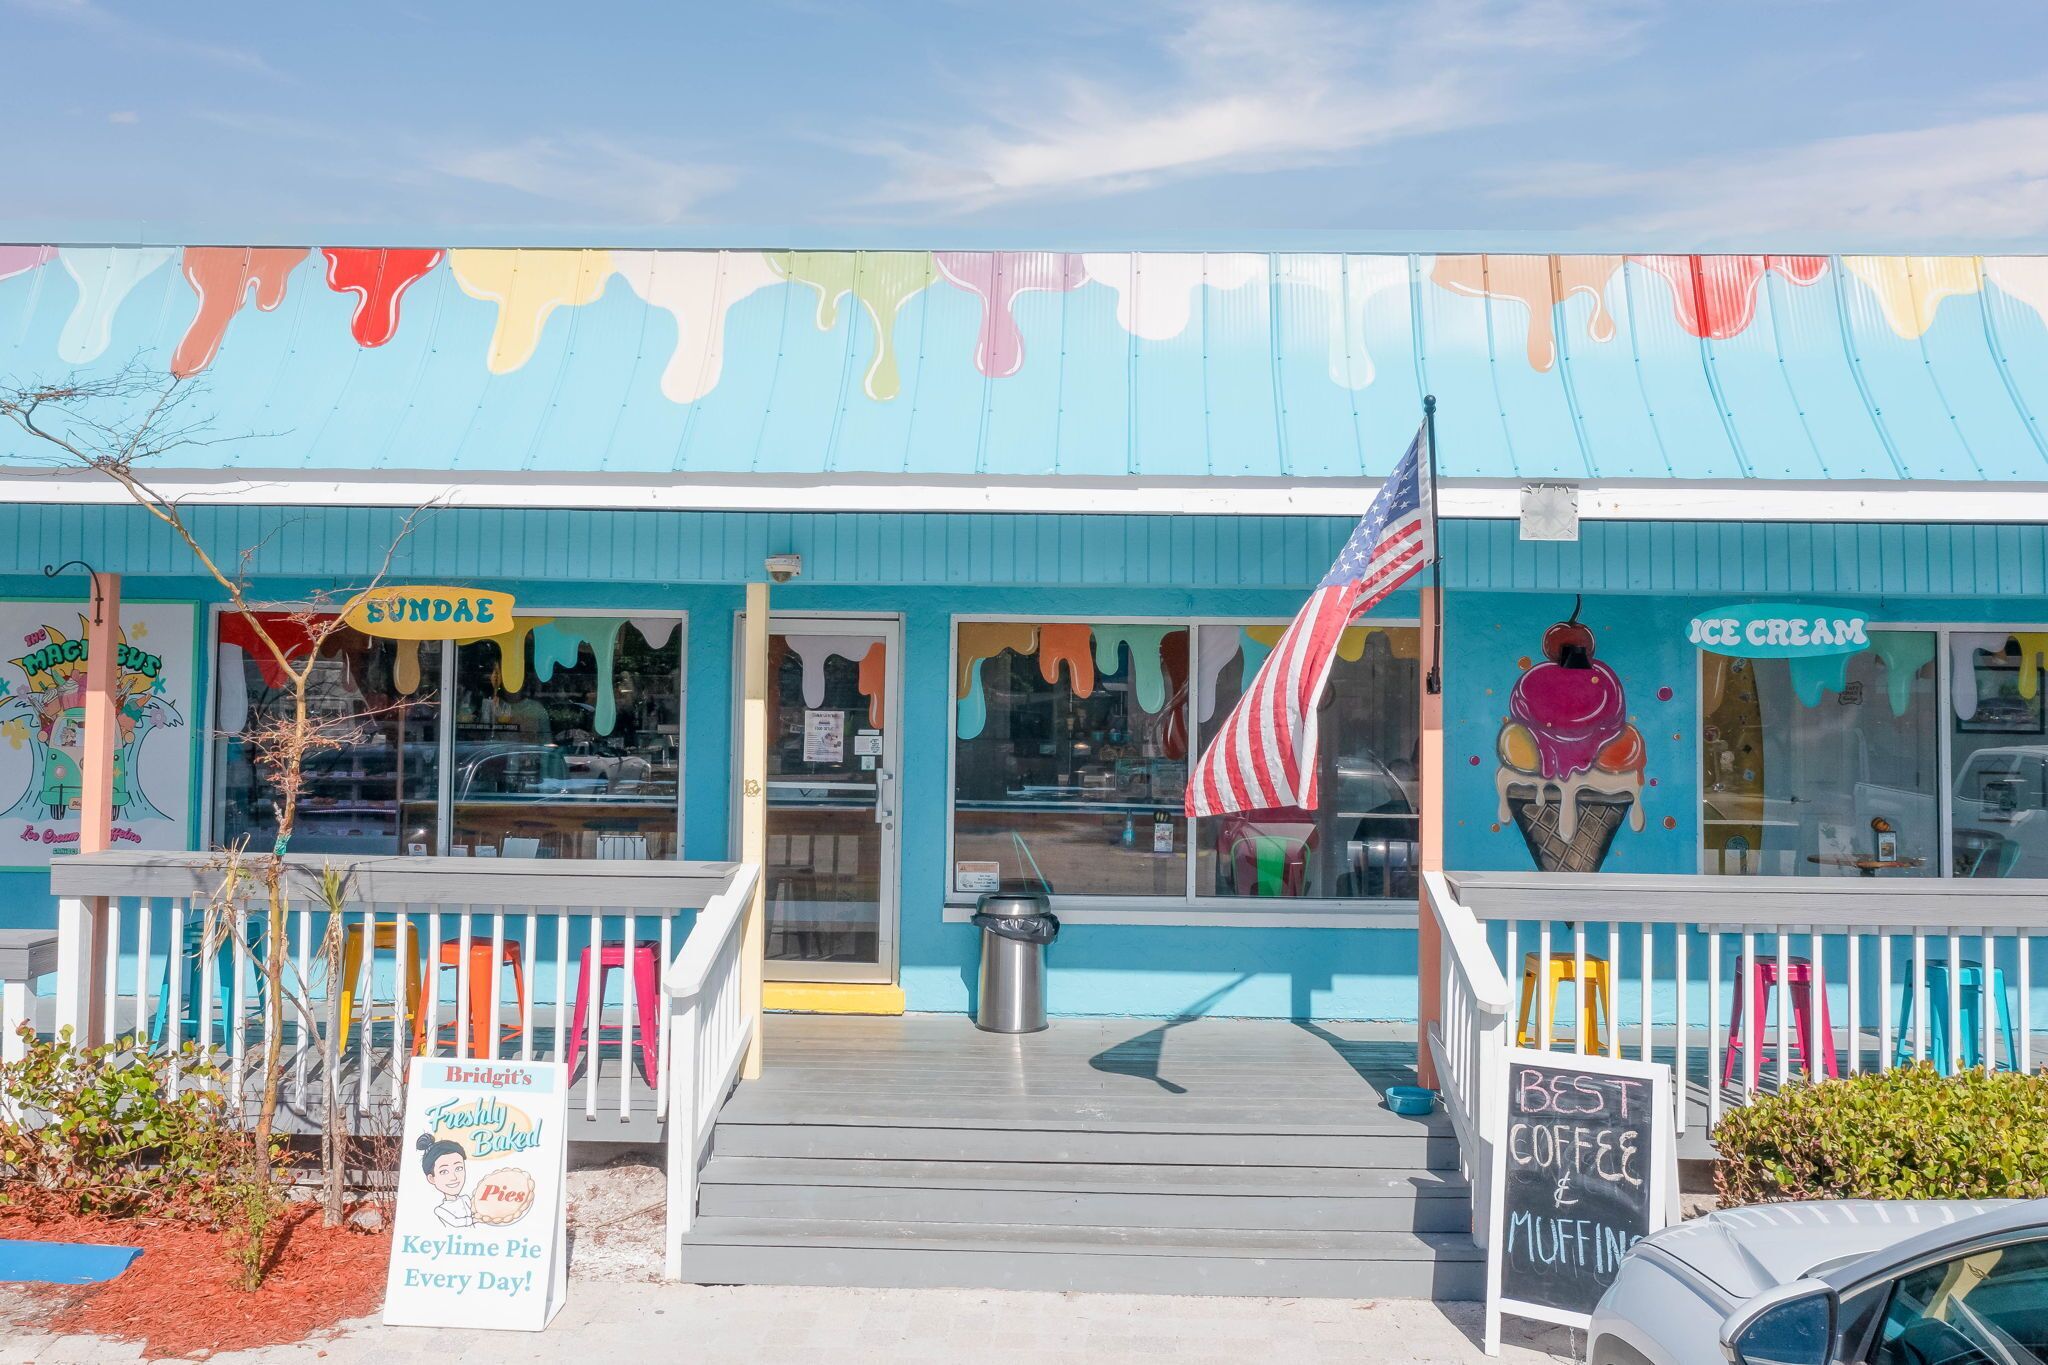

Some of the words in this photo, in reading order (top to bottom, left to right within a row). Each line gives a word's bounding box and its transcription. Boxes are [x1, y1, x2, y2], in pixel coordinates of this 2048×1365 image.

[366, 597, 494, 624] SUNDAE
[24, 629, 47, 647] THE
[1689, 618, 1741, 646] ICE
[1746, 617, 1868, 646] CREAM
[22, 639, 88, 676] MAGI
[117, 643, 162, 678] BUS
[20, 825, 40, 841] Ice
[42, 828, 80, 844] Cream
[111, 828, 142, 843] ffeine
[445, 1065, 532, 1088] Bridgit's
[1519, 1069, 1642, 1119] BEST
[425, 1096, 508, 1133] Freshly
[469, 1118, 543, 1158] Baked
[1509, 1123, 1643, 1187] COFFEE
[479, 1184, 526, 1202] Pies
[1554, 1171, 1579, 1208] &
[401, 1235, 500, 1261] Keylime
[505, 1239, 542, 1259] Pie
[404, 1268, 472, 1295] Every
[478, 1271, 532, 1297] Day!
